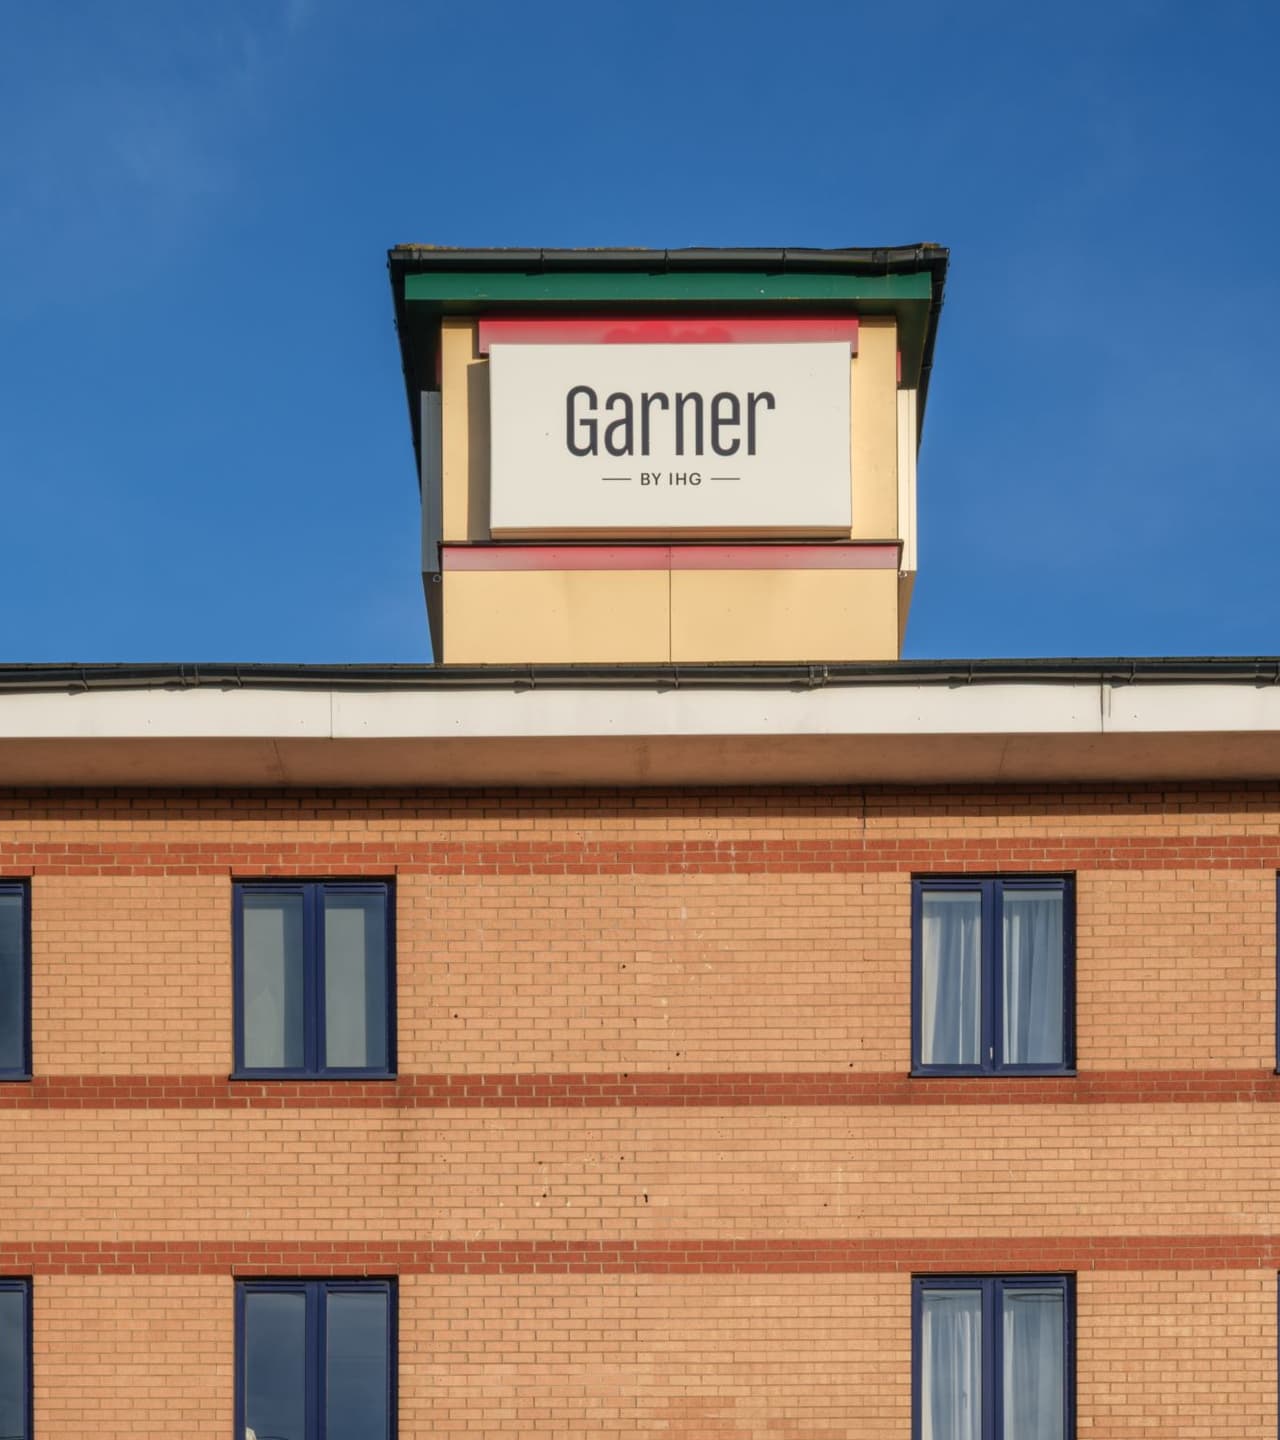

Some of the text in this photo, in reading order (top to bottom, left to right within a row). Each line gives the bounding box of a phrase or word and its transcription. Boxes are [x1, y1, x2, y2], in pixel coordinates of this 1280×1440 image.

[565, 385, 776, 457] Garner
[640, 472, 702, 486] BY IHG
